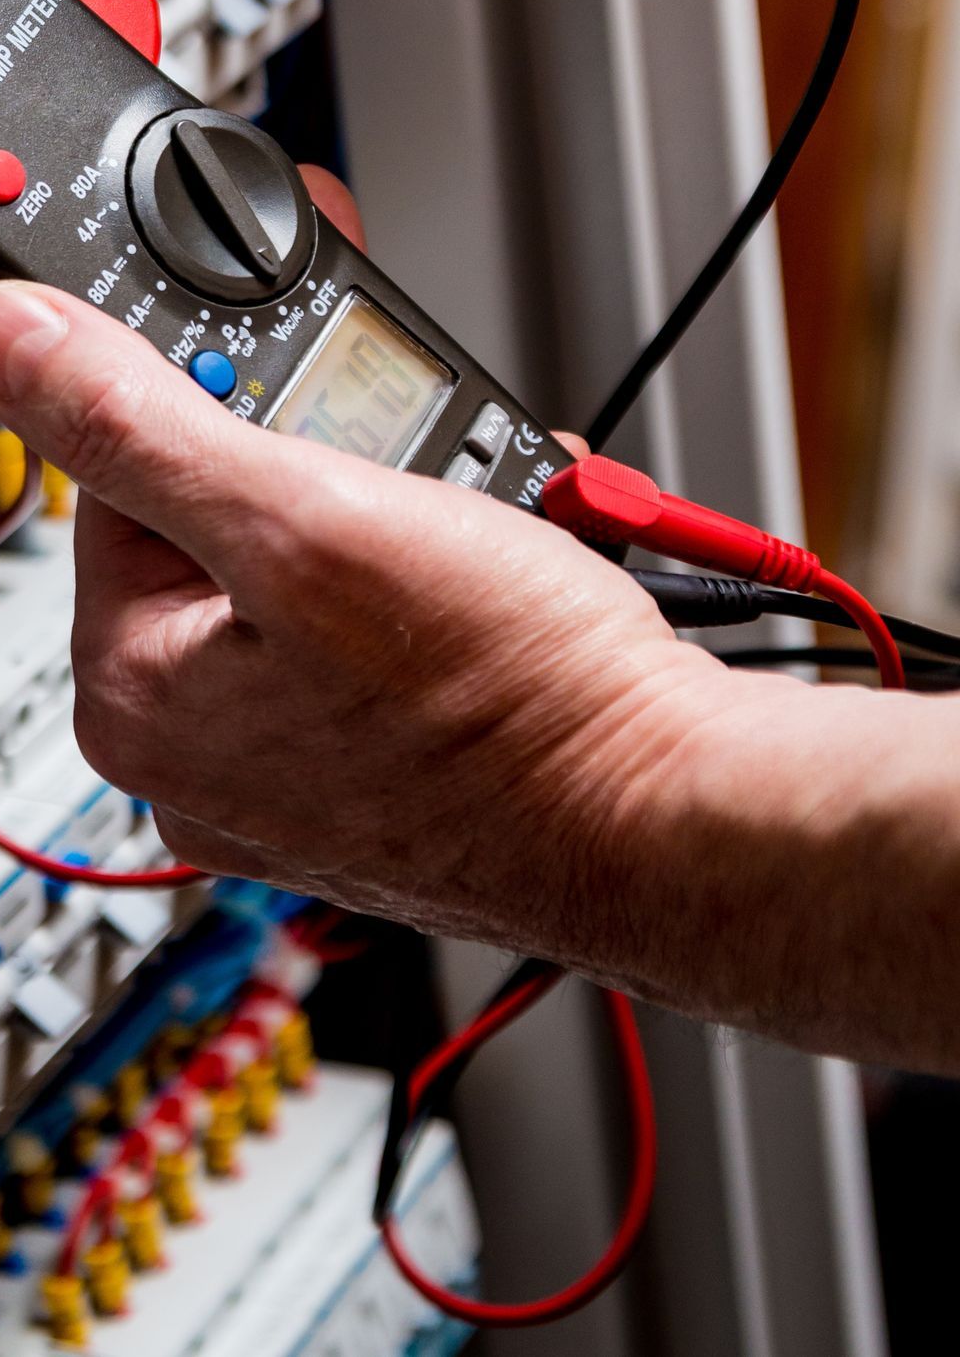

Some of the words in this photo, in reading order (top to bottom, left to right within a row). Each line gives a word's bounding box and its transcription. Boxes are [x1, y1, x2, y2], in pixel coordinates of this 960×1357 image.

[14, 179, 53, 227] ZERO
[309, 278, 339, 318] OFF
[241, 336, 258, 359] CAP
[480, 412, 506, 443] Hz/%
[533, 459, 556, 483] Hz
